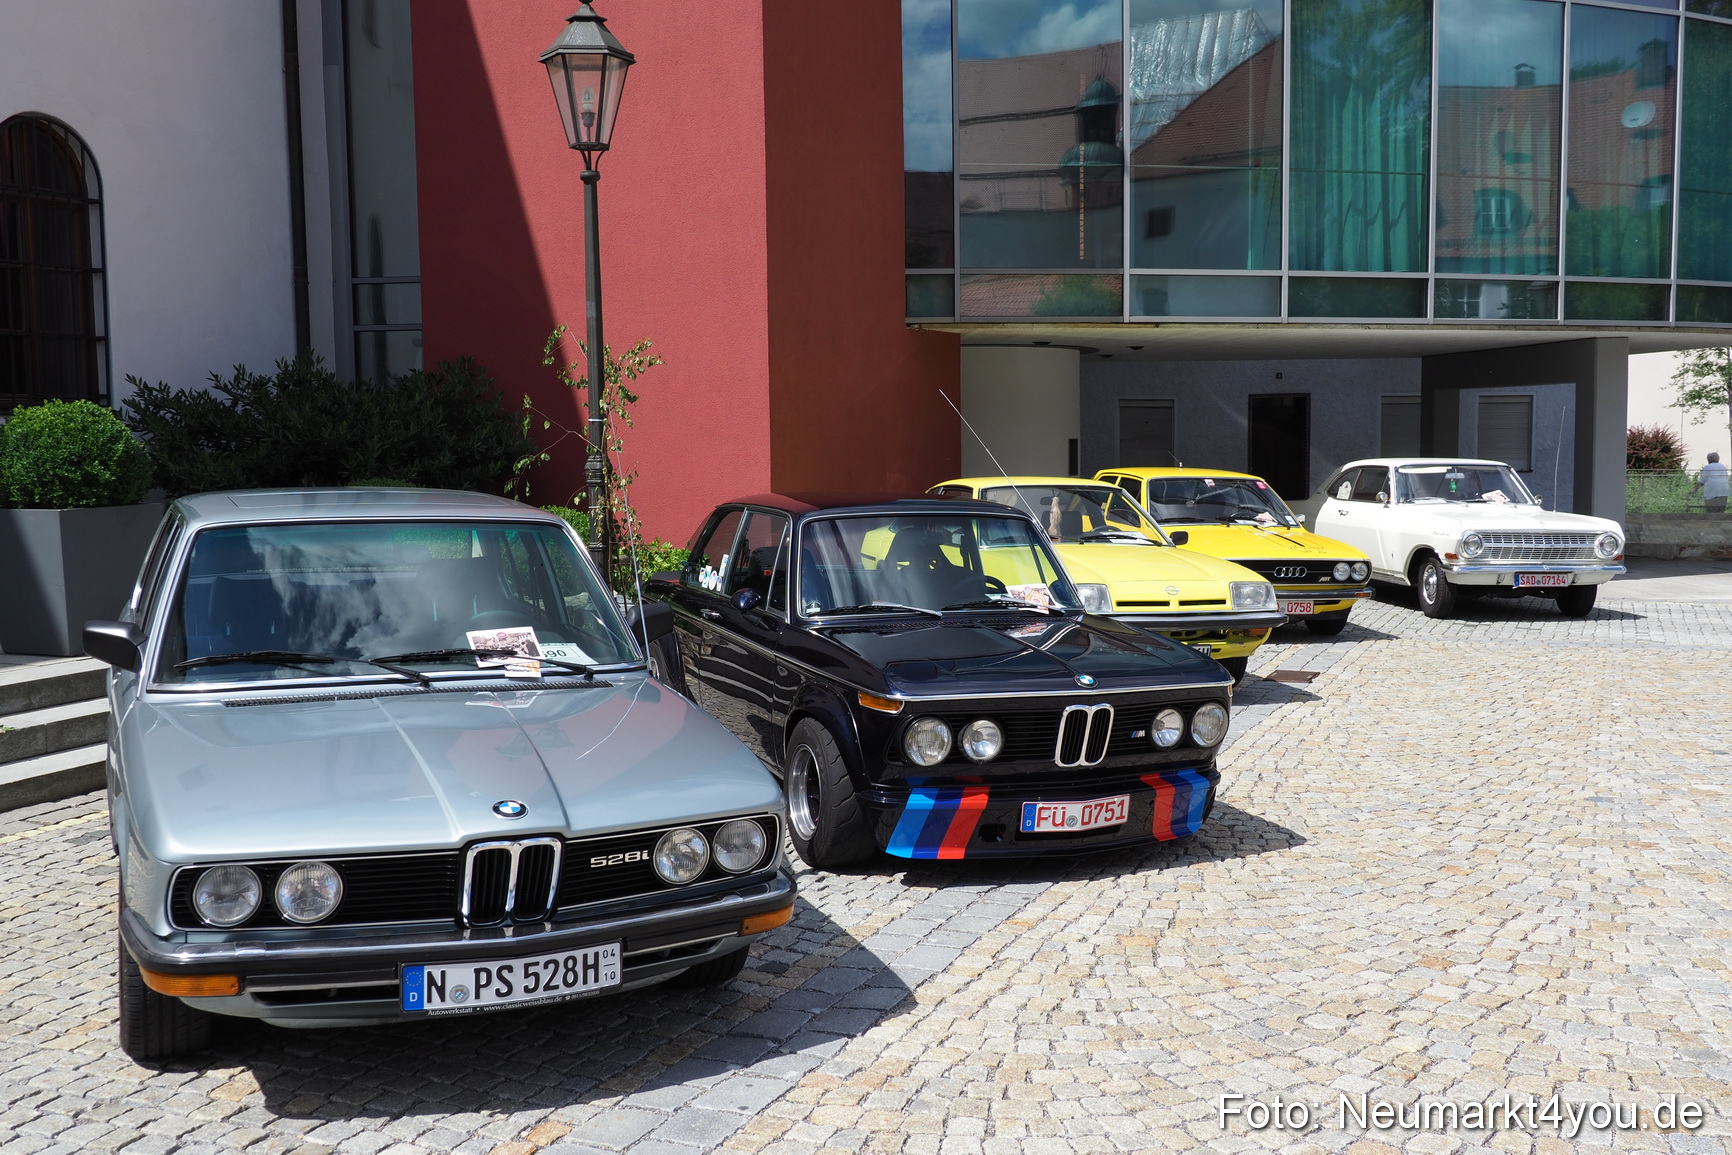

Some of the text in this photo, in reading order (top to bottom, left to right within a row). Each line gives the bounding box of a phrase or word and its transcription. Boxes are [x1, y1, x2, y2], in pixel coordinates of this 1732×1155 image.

[1520, 575, 1567, 585] SAD 07164
[1286, 602, 1312, 613] 0758
[1036, 799, 1126, 828] FÜ 0751
[1026, 819, 1032, 827] D
[590, 849, 650, 868] 528i
[602, 948, 616, 959] 04
[426, 950, 600, 1004] N PS 528H
[603, 971, 616, 981] 10
[409, 992, 418, 1002] D
[427, 996, 562, 1016] Autowerkstatt www.classicweissblau.de
